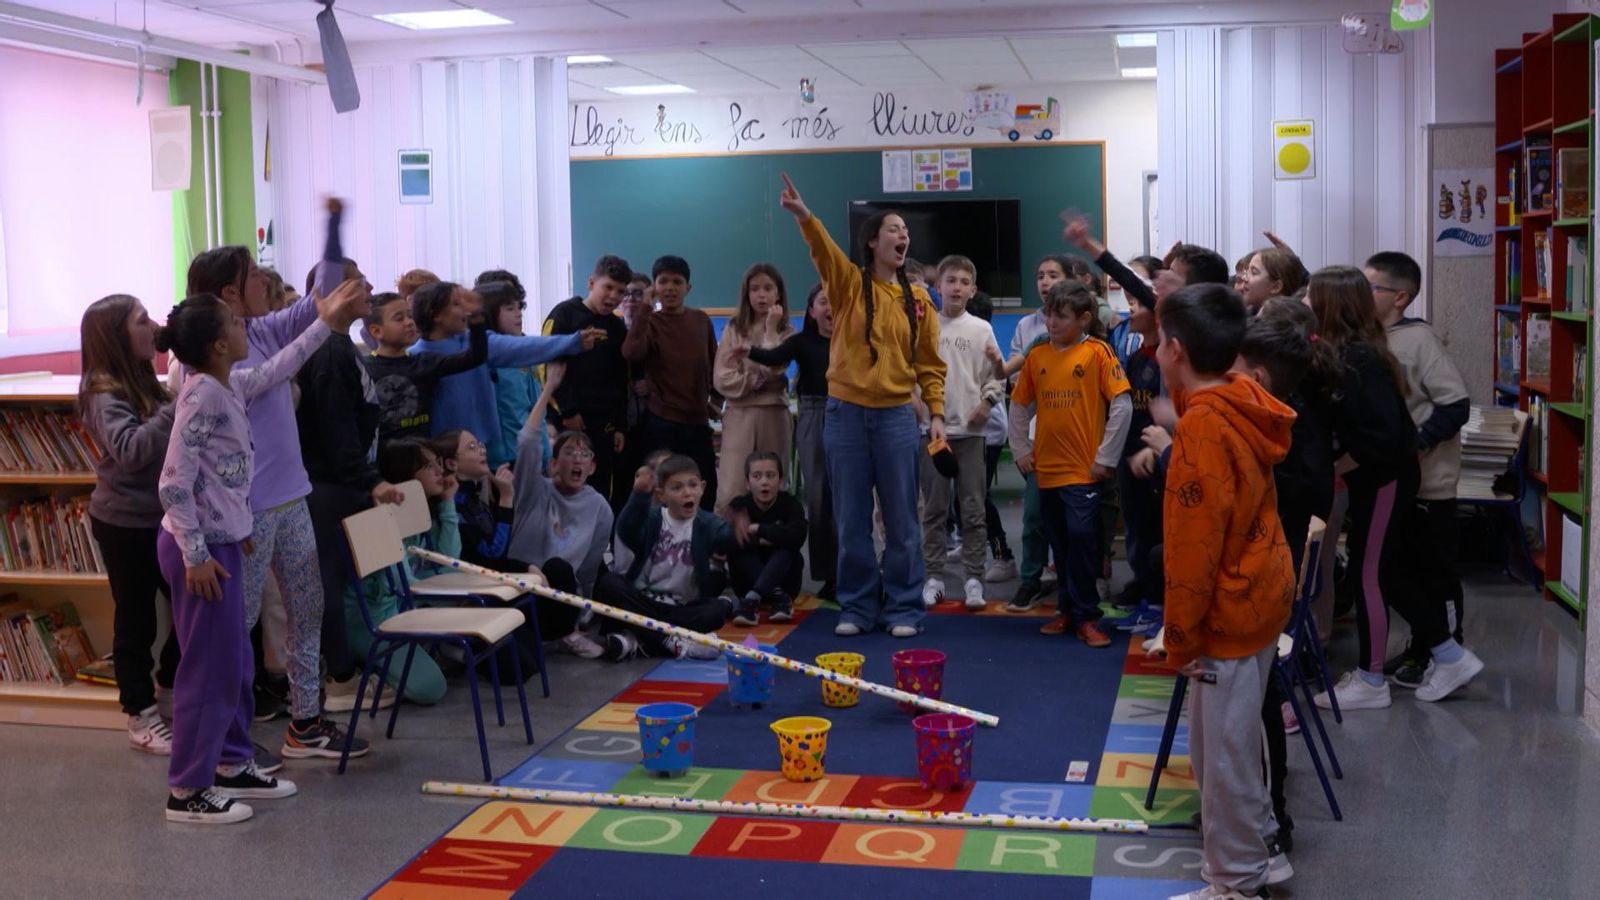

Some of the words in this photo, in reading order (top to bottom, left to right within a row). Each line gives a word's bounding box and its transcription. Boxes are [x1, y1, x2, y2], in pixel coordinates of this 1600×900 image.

[571, 104, 645, 156] Llegir
[728, 102, 765, 152] fa
[782, 107, 843, 141] més
[479, 807, 564, 838] N
[603, 815, 683, 846] O
[727, 822, 802, 852] P
[855, 828, 936, 863] Q
[991, 835, 1062, 868] R
